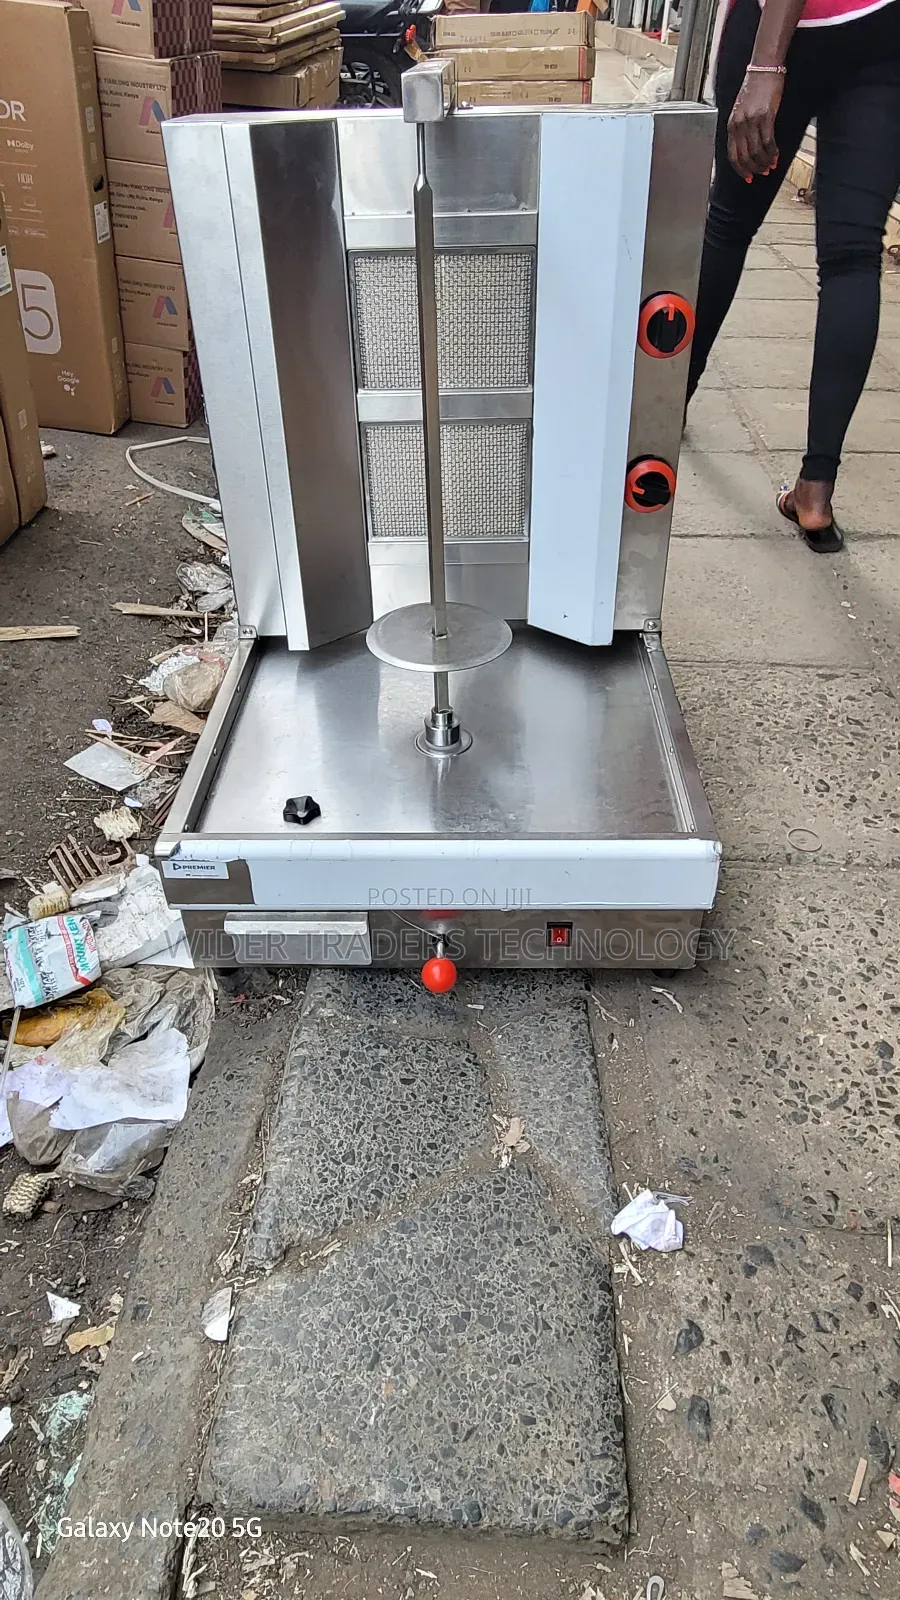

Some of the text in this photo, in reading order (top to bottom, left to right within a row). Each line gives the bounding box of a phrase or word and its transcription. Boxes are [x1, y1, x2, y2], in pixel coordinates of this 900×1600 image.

[130, 81, 155, 90] INDUSTRY
[15, 140, 34, 151] Dolby
[61, 369, 74, 378] Hey
[57, 375, 80, 385] Google
